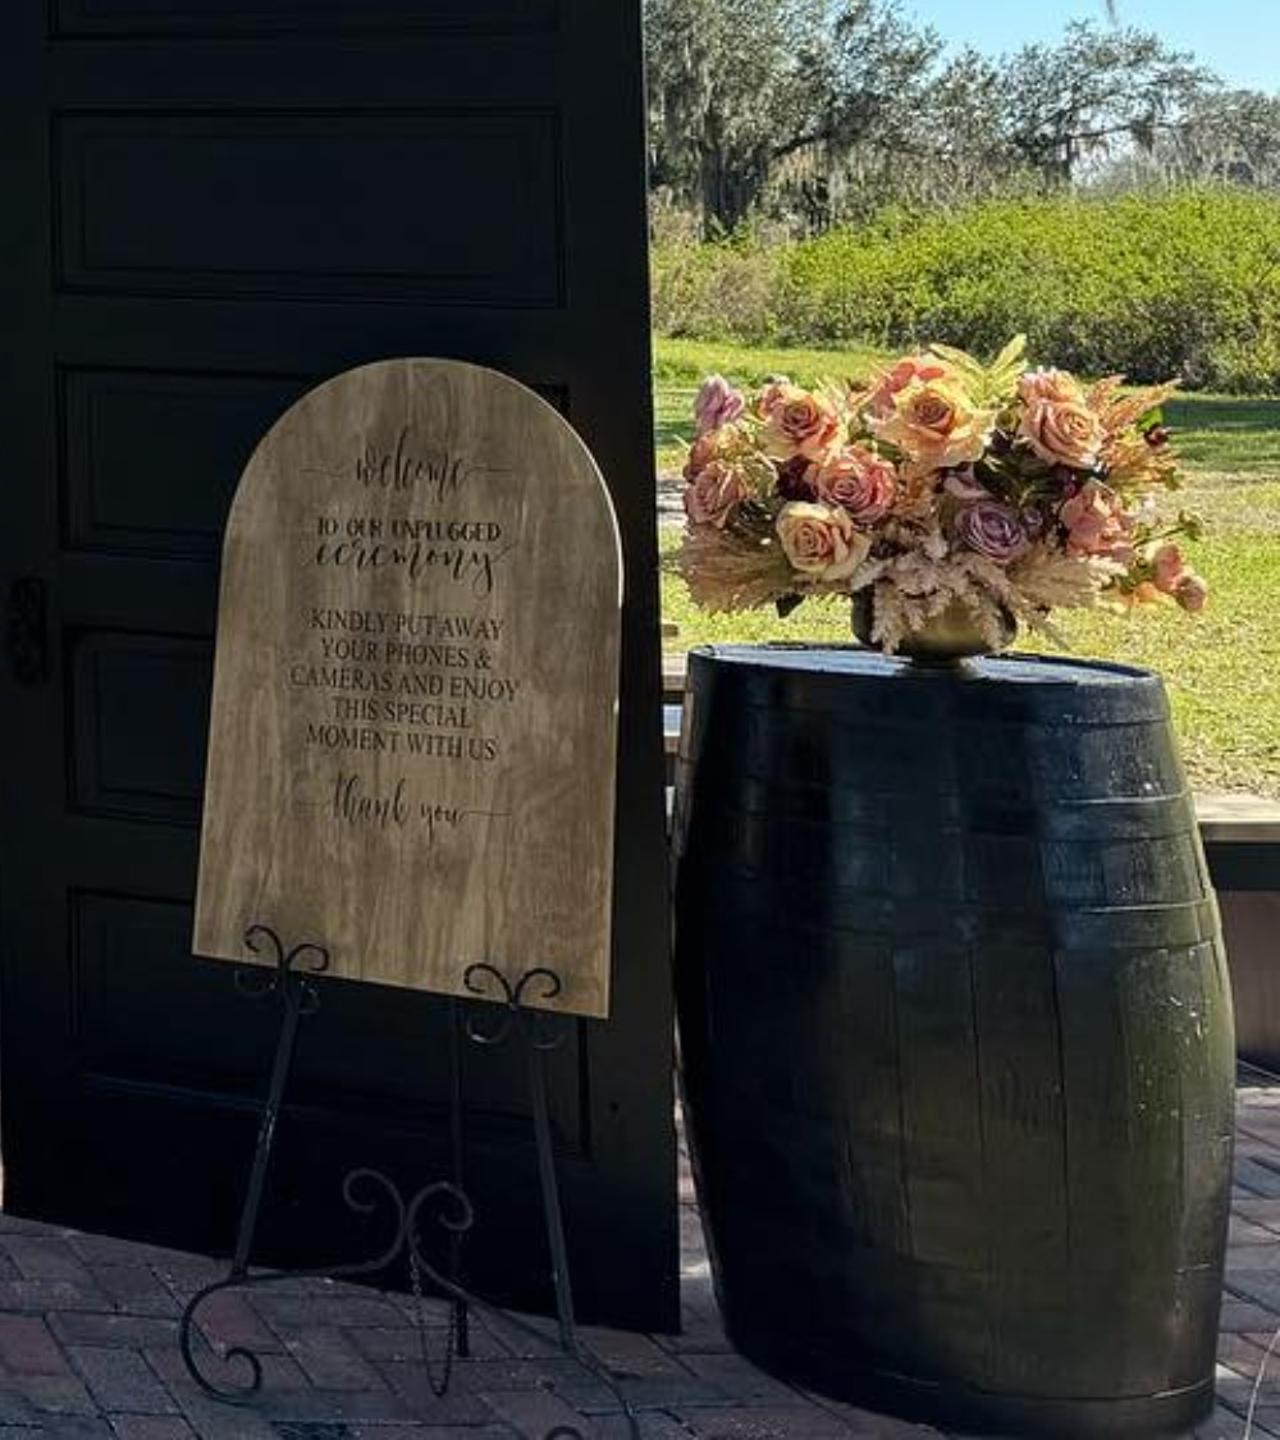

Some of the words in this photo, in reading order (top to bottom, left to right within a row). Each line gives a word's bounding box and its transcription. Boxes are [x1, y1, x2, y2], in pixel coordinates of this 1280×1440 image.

[316, 517, 339, 538] TO
[346, 517, 383, 539] OUR
[391, 519, 503, 543] UNPLUGGED
[314, 539, 512, 600] ceremony
[309, 608, 391, 634] KINDLY
[396, 613, 438, 637] PUT
[439, 615, 505, 641] AWAY
[320, 636, 378, 662] YOUR
[385, 640, 470, 671] PHONES
[474, 648, 493, 671] &
[290, 664, 393, 692] CAMERAS
[397, 673, 444, 697] AND
[449, 676, 520, 703] ENJOY
[332, 696, 379, 721] THIS
[383, 700, 473, 729] SPECIAL
[306, 723, 403, 754] MOMENT
[406, 732, 463, 759] WITH
[468, 738, 498, 761] US
[332, 770, 411, 828] thank
[419, 802, 470, 851] you
